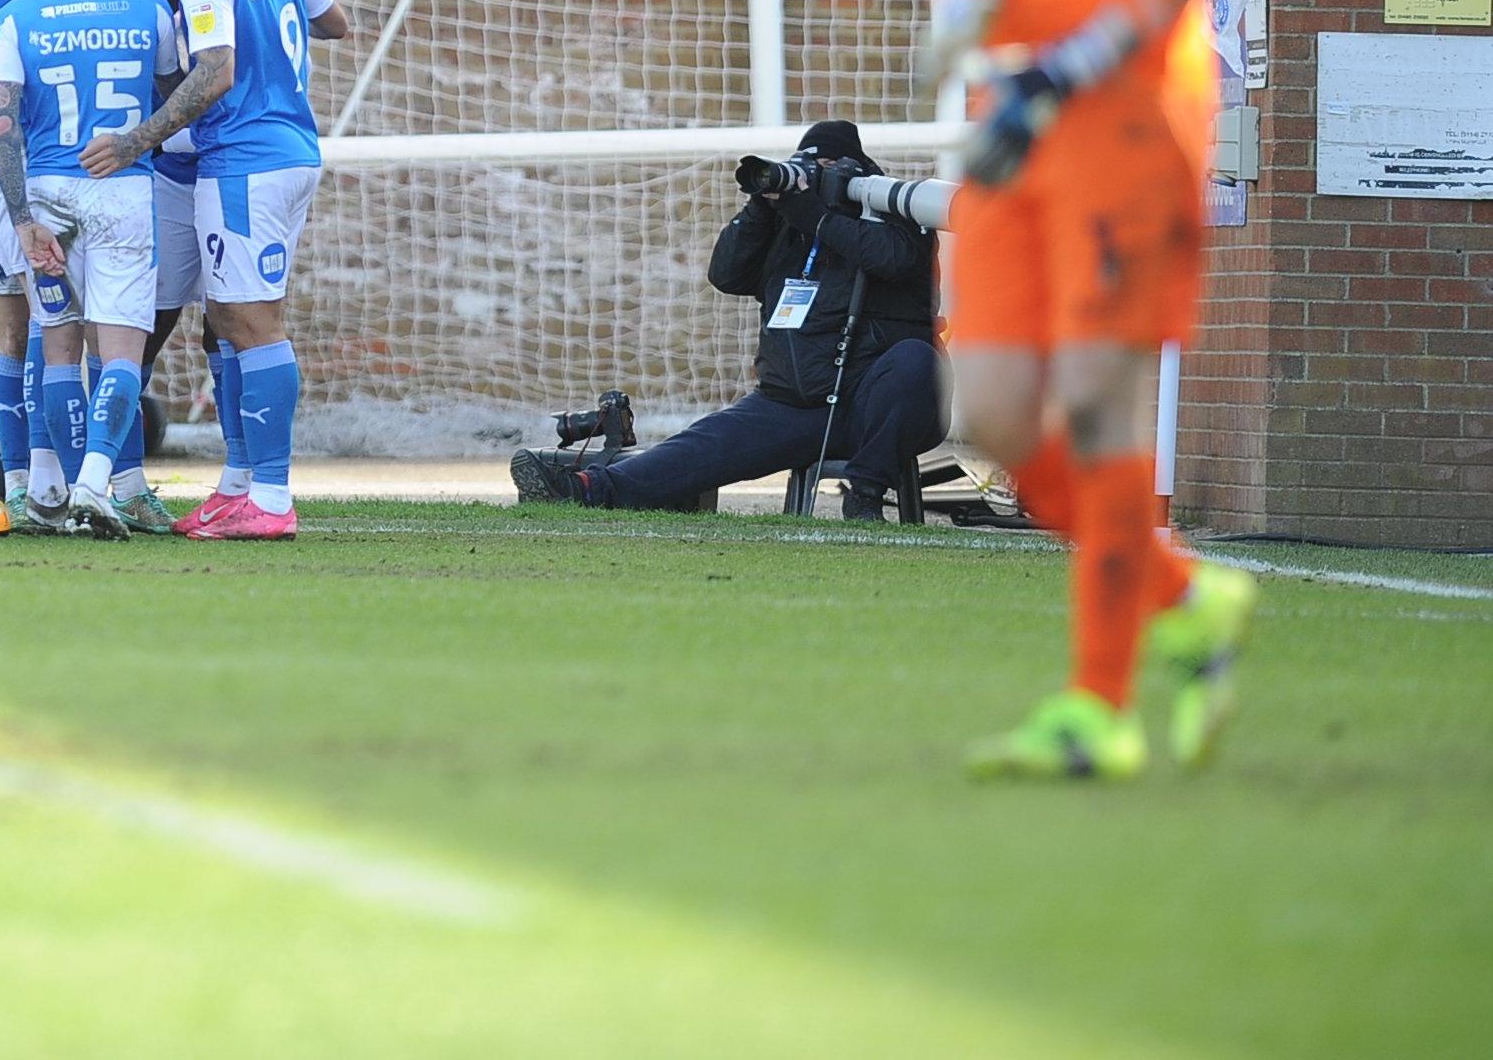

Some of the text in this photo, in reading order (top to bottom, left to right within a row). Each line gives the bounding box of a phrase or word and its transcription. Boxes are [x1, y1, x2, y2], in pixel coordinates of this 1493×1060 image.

[39, 28, 152, 55] SZMODICS
[280, 2, 304, 92] 9
[38, 60, 142, 146] 15
[206, 233, 225, 270] 9
[22, 361, 37, 413] PUFC
[93, 377, 117, 422] PUFC
[67, 398, 86, 449] PUFC
